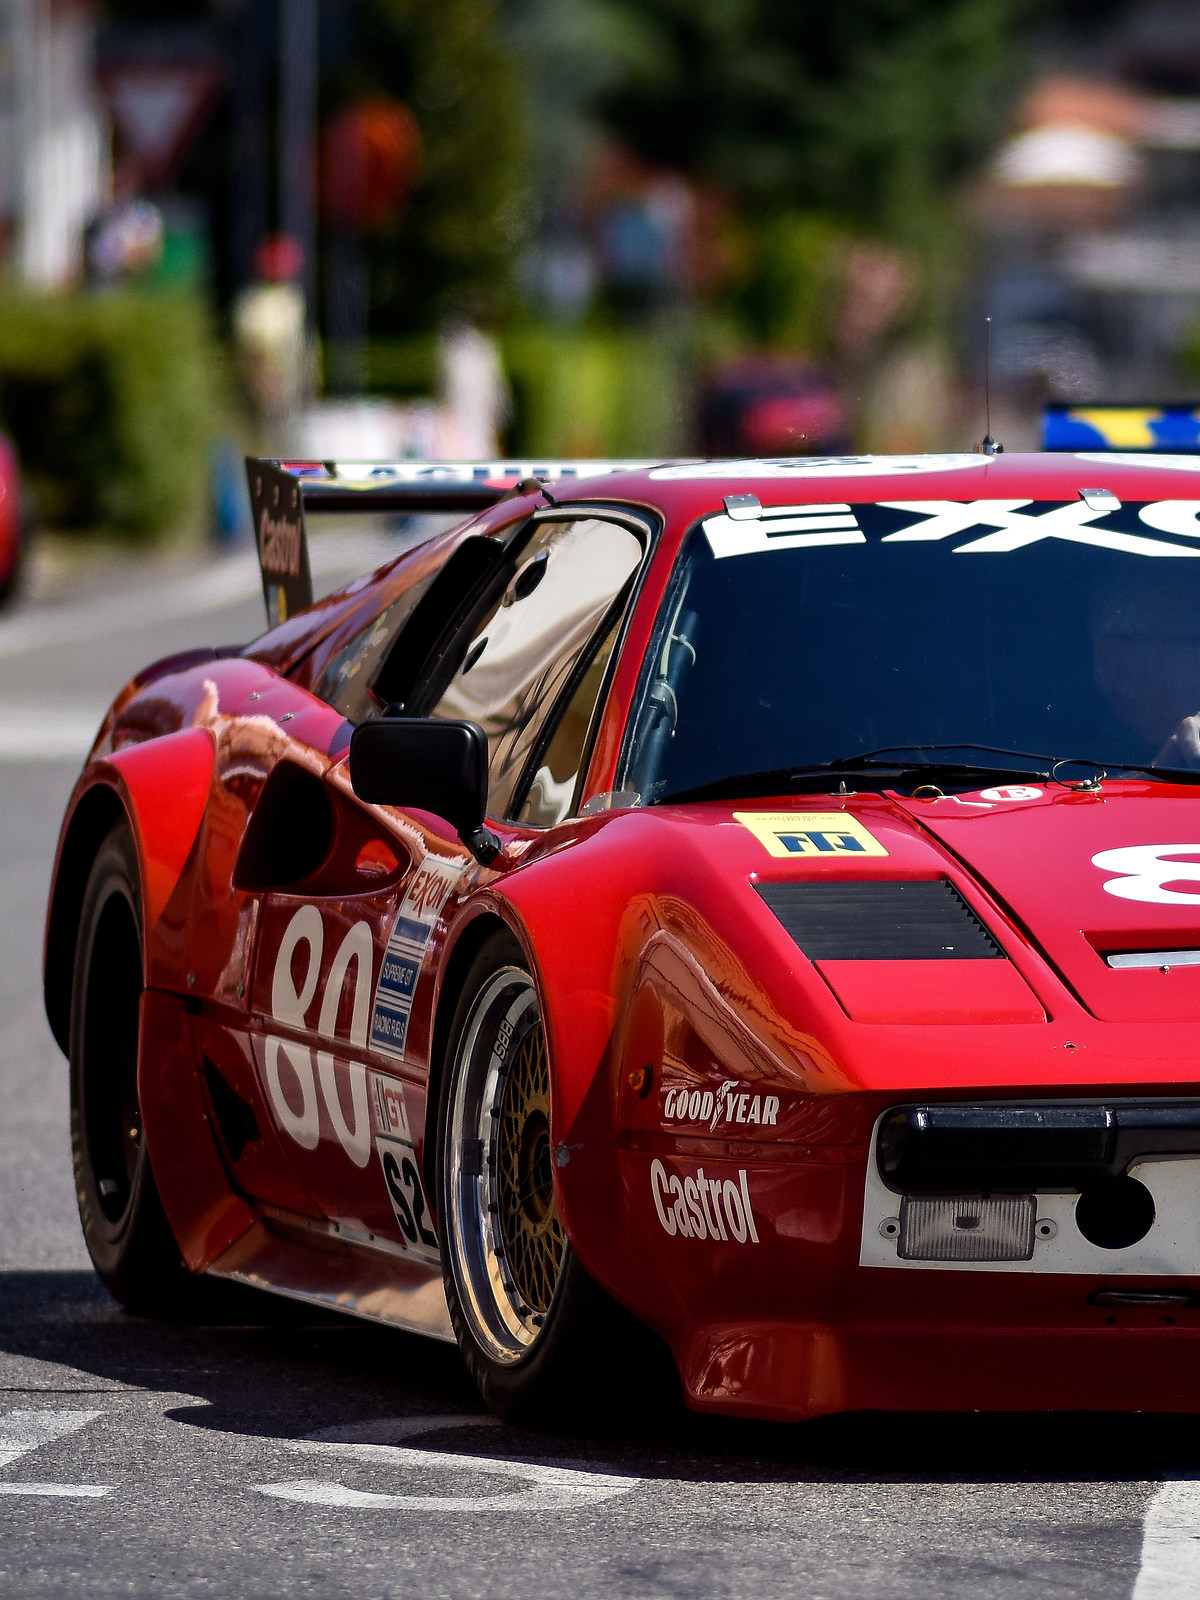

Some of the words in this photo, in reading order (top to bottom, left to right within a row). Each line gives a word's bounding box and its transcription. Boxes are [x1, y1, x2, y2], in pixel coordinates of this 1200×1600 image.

[408, 869, 453, 918] EXXON
[383, 962, 406, 984] SUPREME
[265, 905, 373, 1167] 80
[385, 1087, 406, 1130] GT
[383, 1151, 440, 1248] S2
[651, 1158, 760, 1243] Castrol
